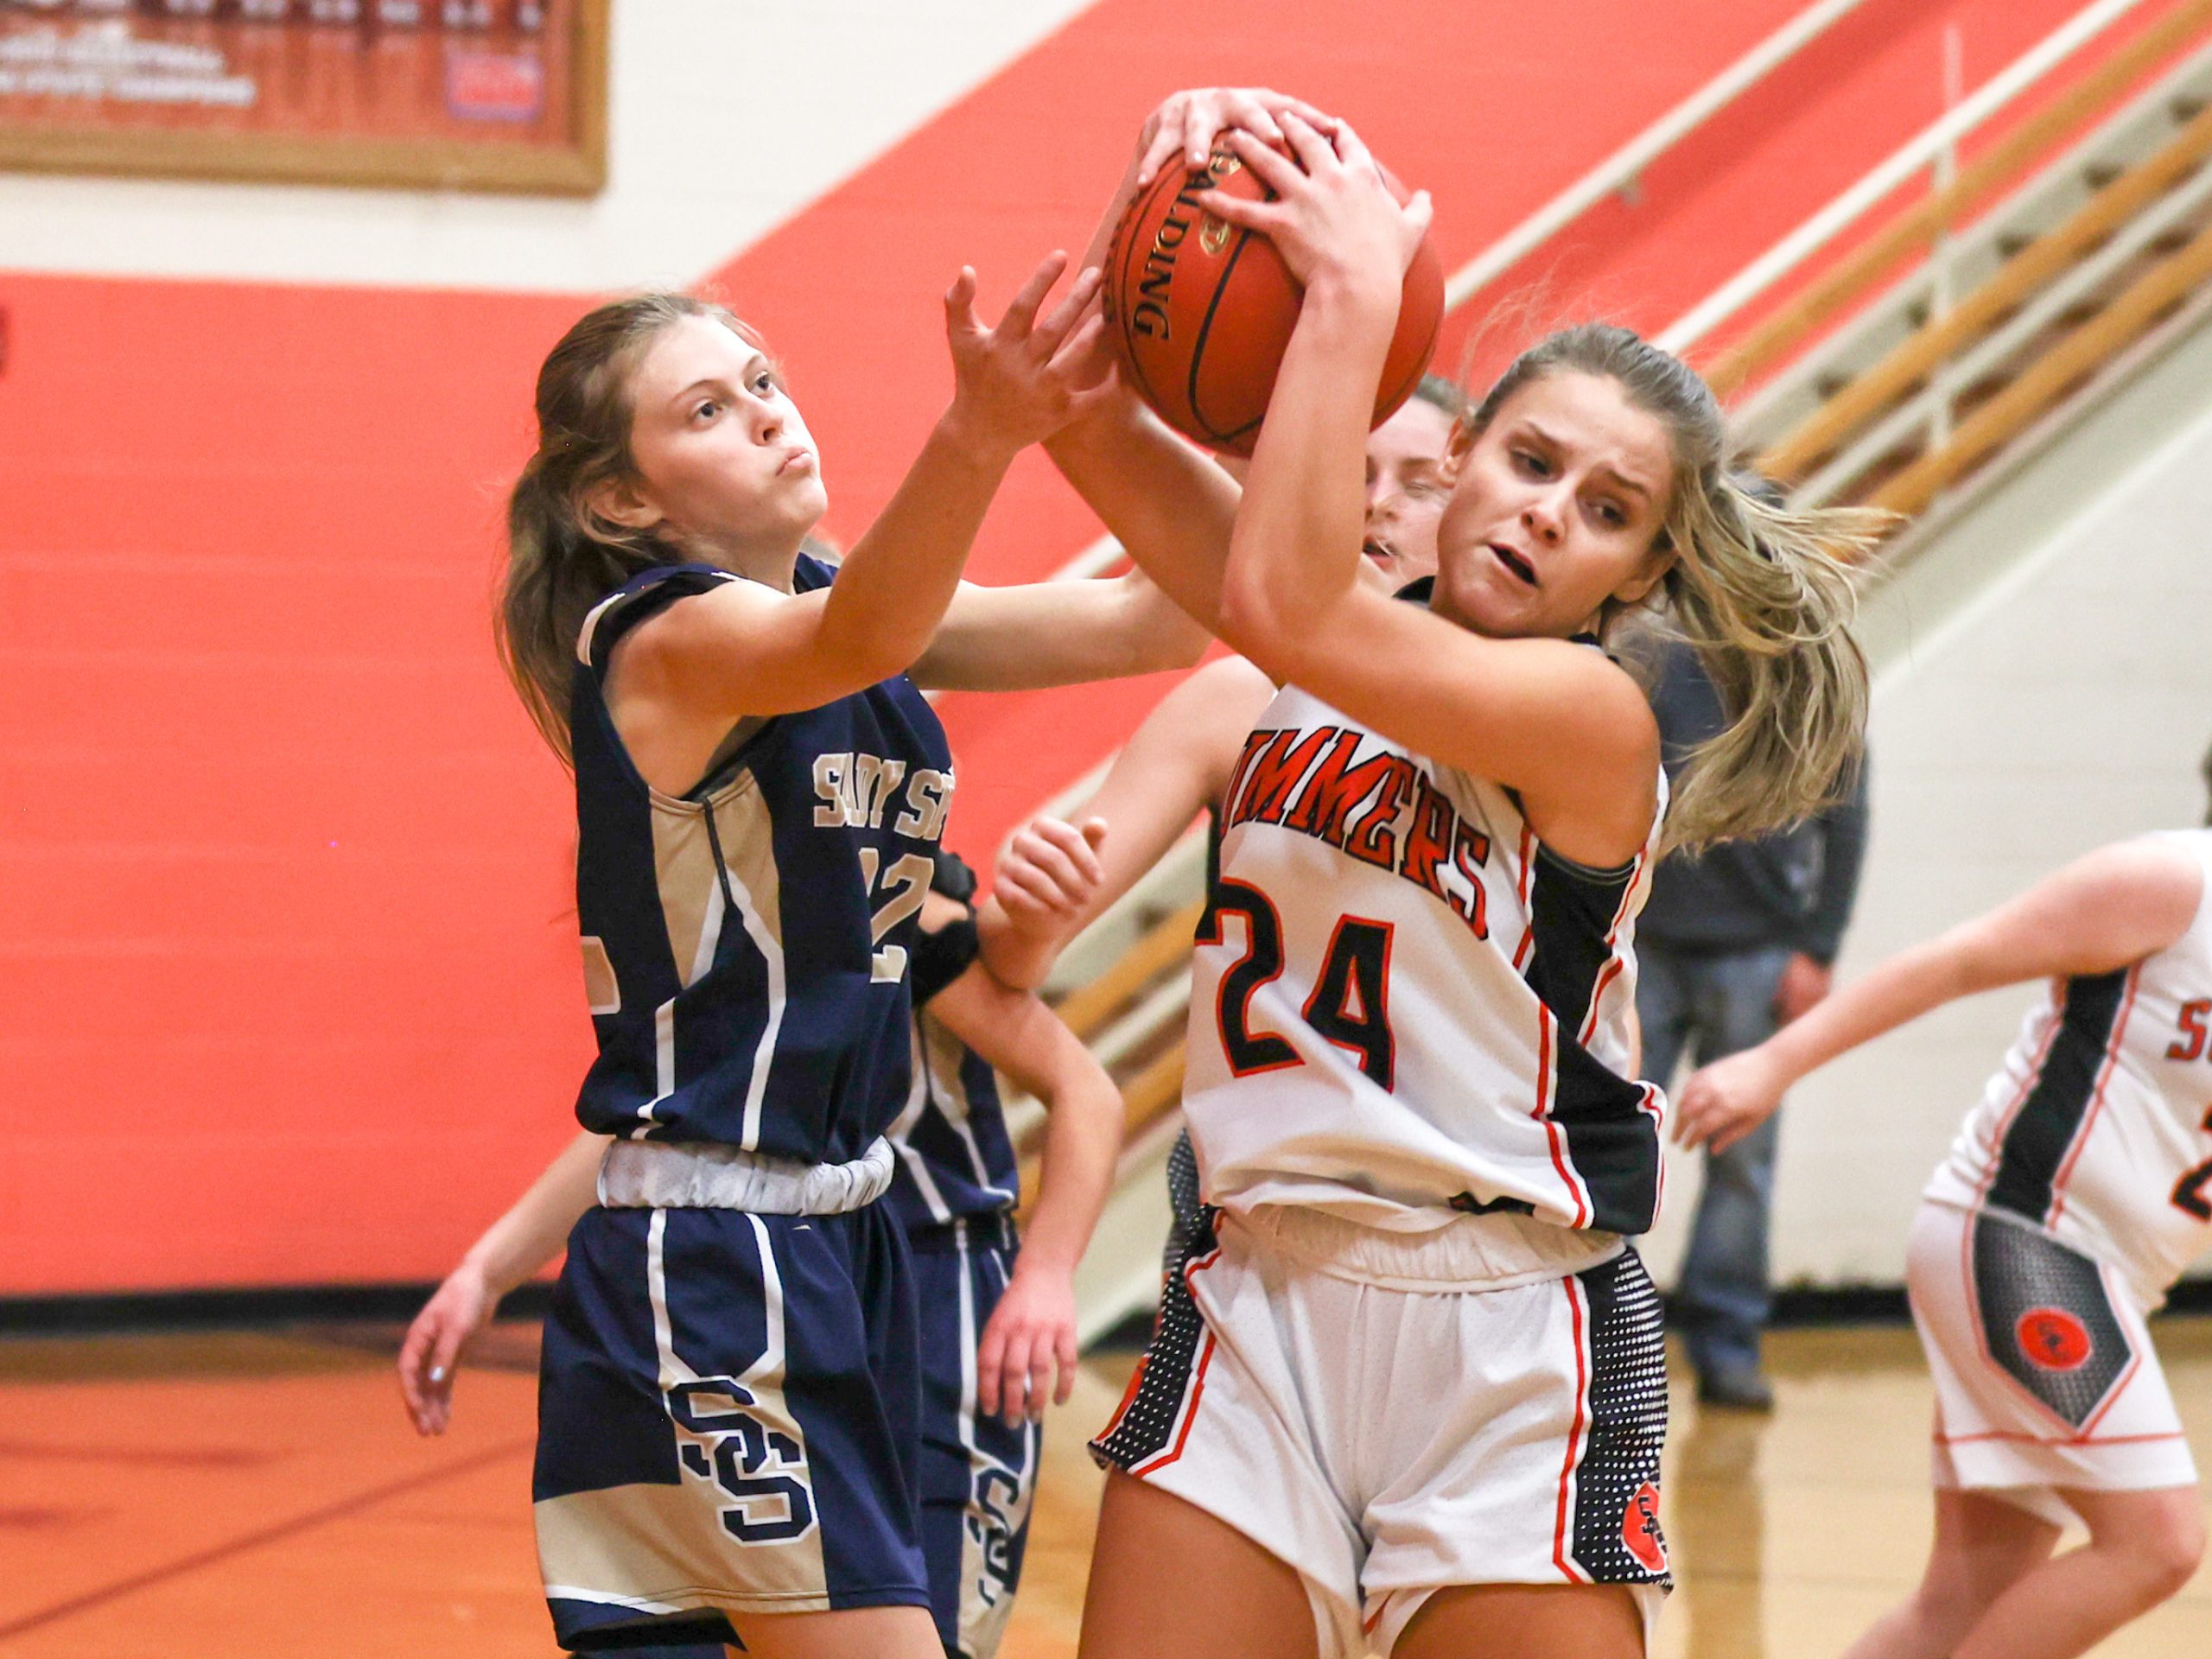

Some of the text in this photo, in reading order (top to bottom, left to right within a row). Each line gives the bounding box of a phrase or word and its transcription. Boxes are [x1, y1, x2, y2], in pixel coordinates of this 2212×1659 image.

[1132, 169, 1218, 340] ALDING
[1221, 726, 1491, 941] MMERS
[1194, 876, 1395, 1094] 24
